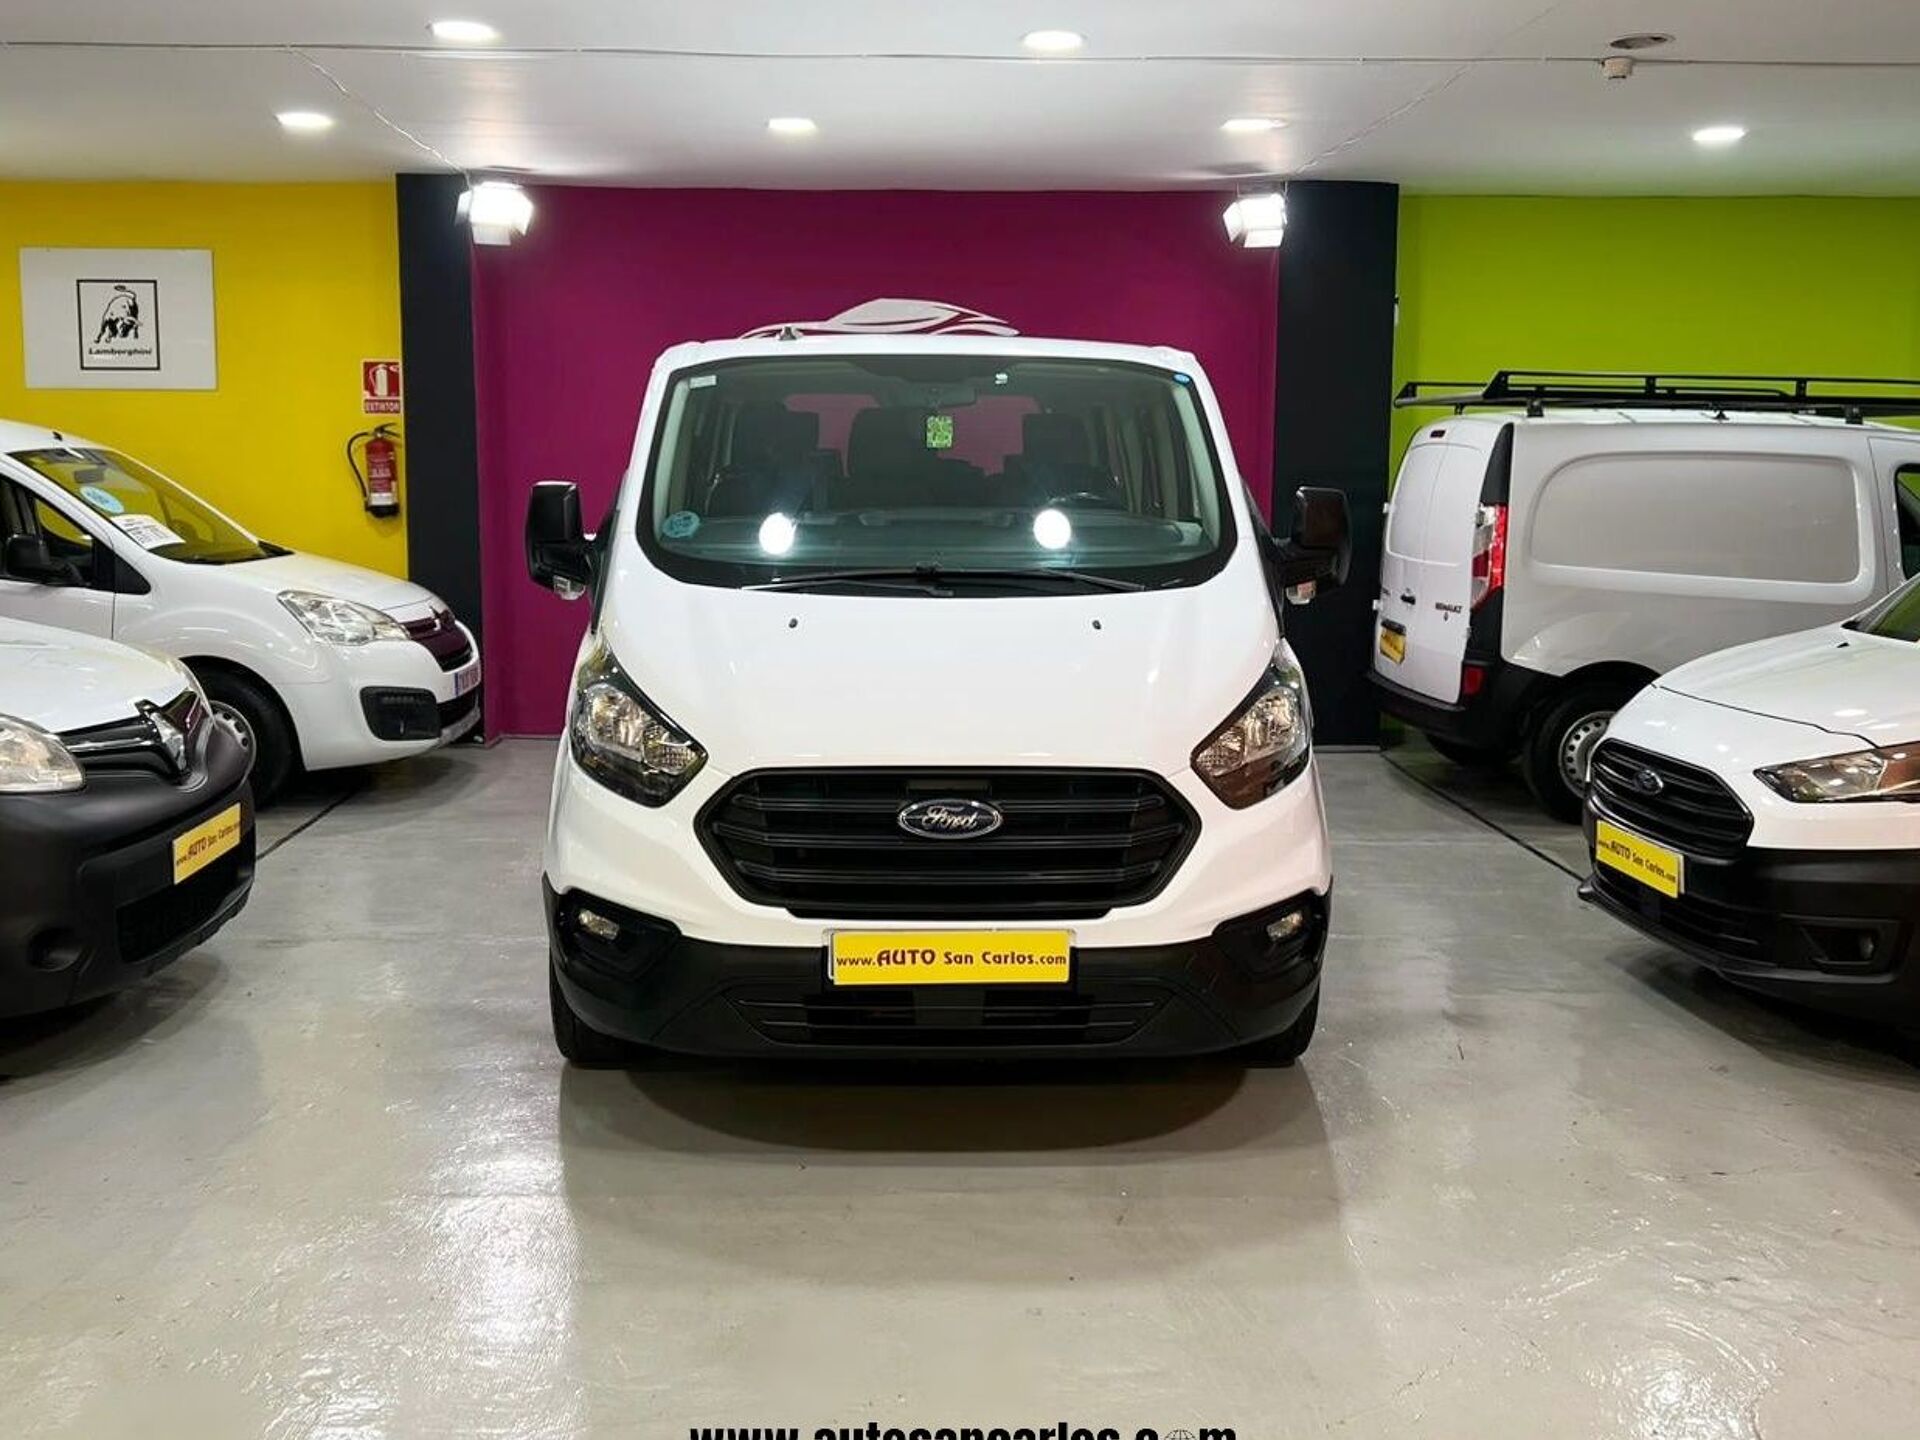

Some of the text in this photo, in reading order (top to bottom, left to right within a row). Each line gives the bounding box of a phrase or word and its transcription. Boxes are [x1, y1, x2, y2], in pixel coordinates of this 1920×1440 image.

[88, 347, 152, 356] Lamborghini
[921, 805, 978, 829] Ford
[836, 949, 1067, 967] www.AUTO San Carlos.com
